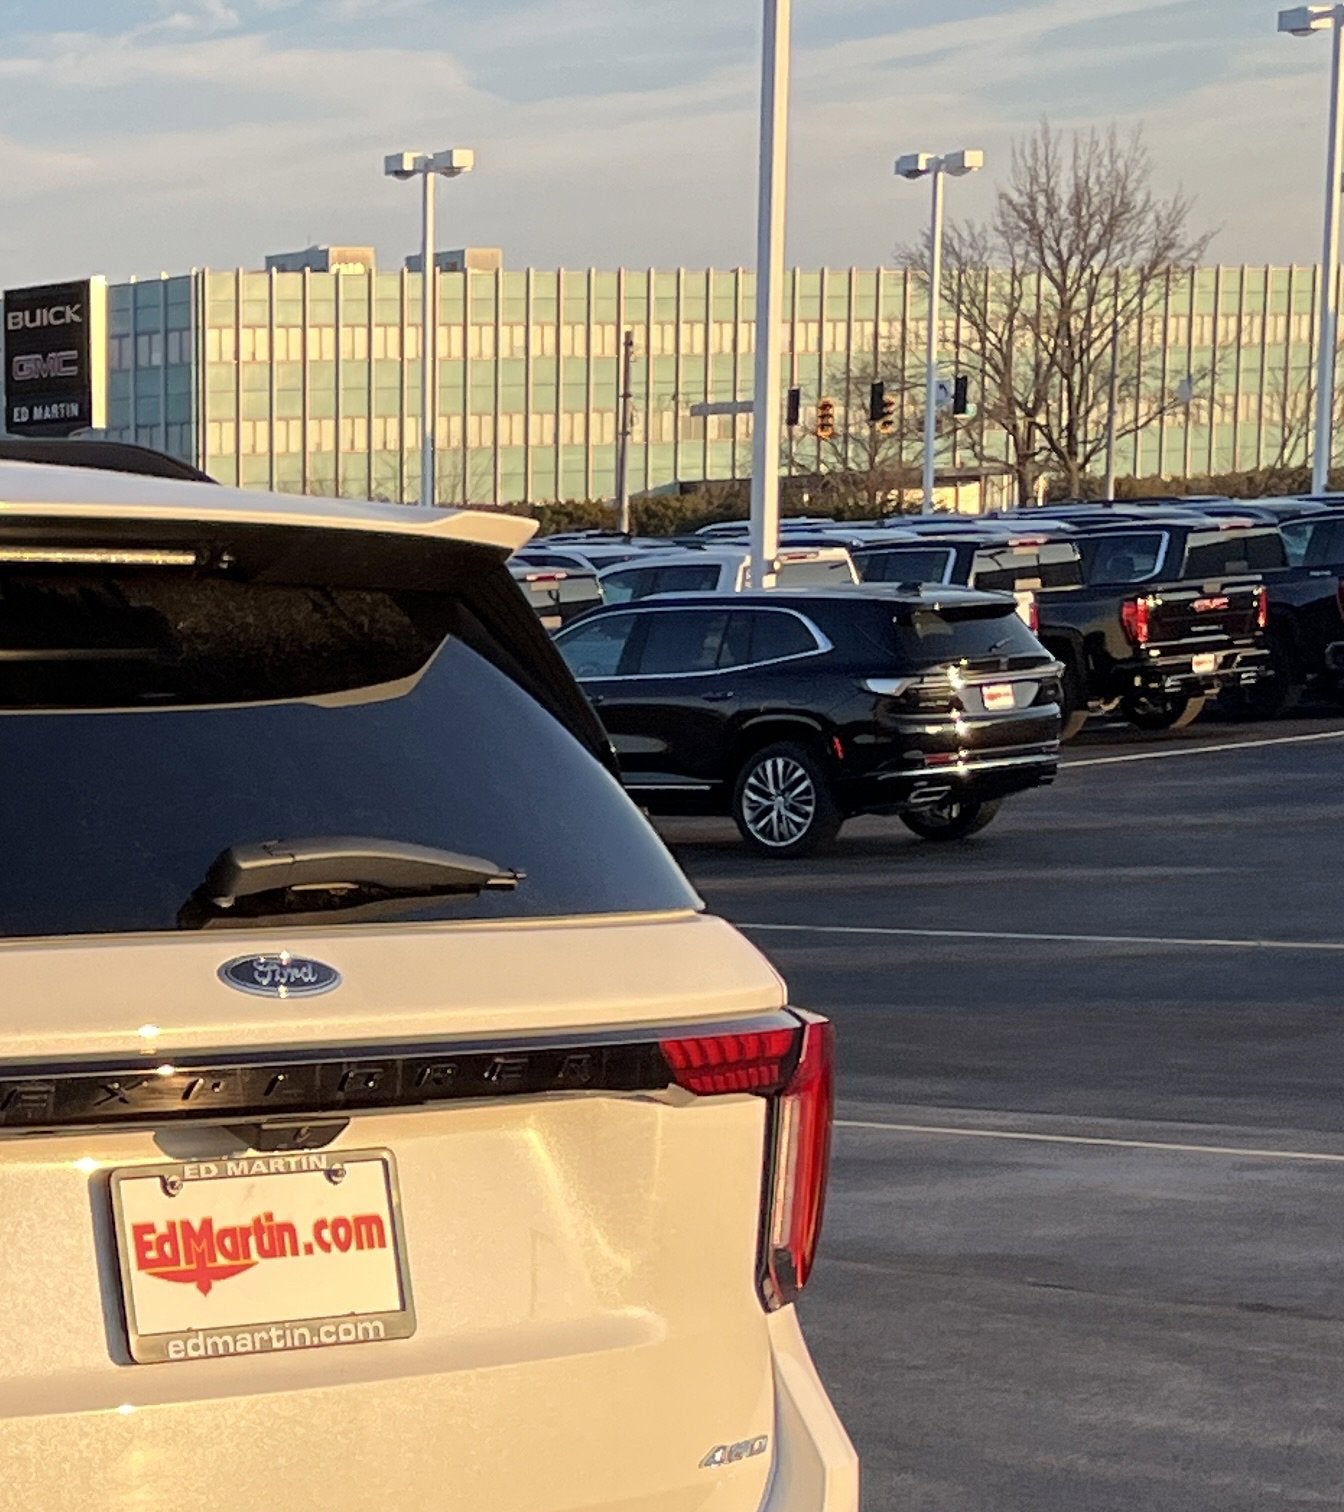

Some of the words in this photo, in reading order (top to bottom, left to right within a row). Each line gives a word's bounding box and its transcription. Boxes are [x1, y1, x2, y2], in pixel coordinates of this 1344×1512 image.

[7, 304, 82, 330] BUICK
[13, 350, 78, 380] GMC
[13, 406, 29, 422] ED
[33, 403, 79, 420] MARTIN
[252, 958, 318, 986] Ford
[183, 1162, 219, 1181] ED
[226, 1154, 328, 1177] MARTIN
[131, 1210, 387, 1272] EdMartin.com
[167, 1317, 385, 1360] edmartin.com
